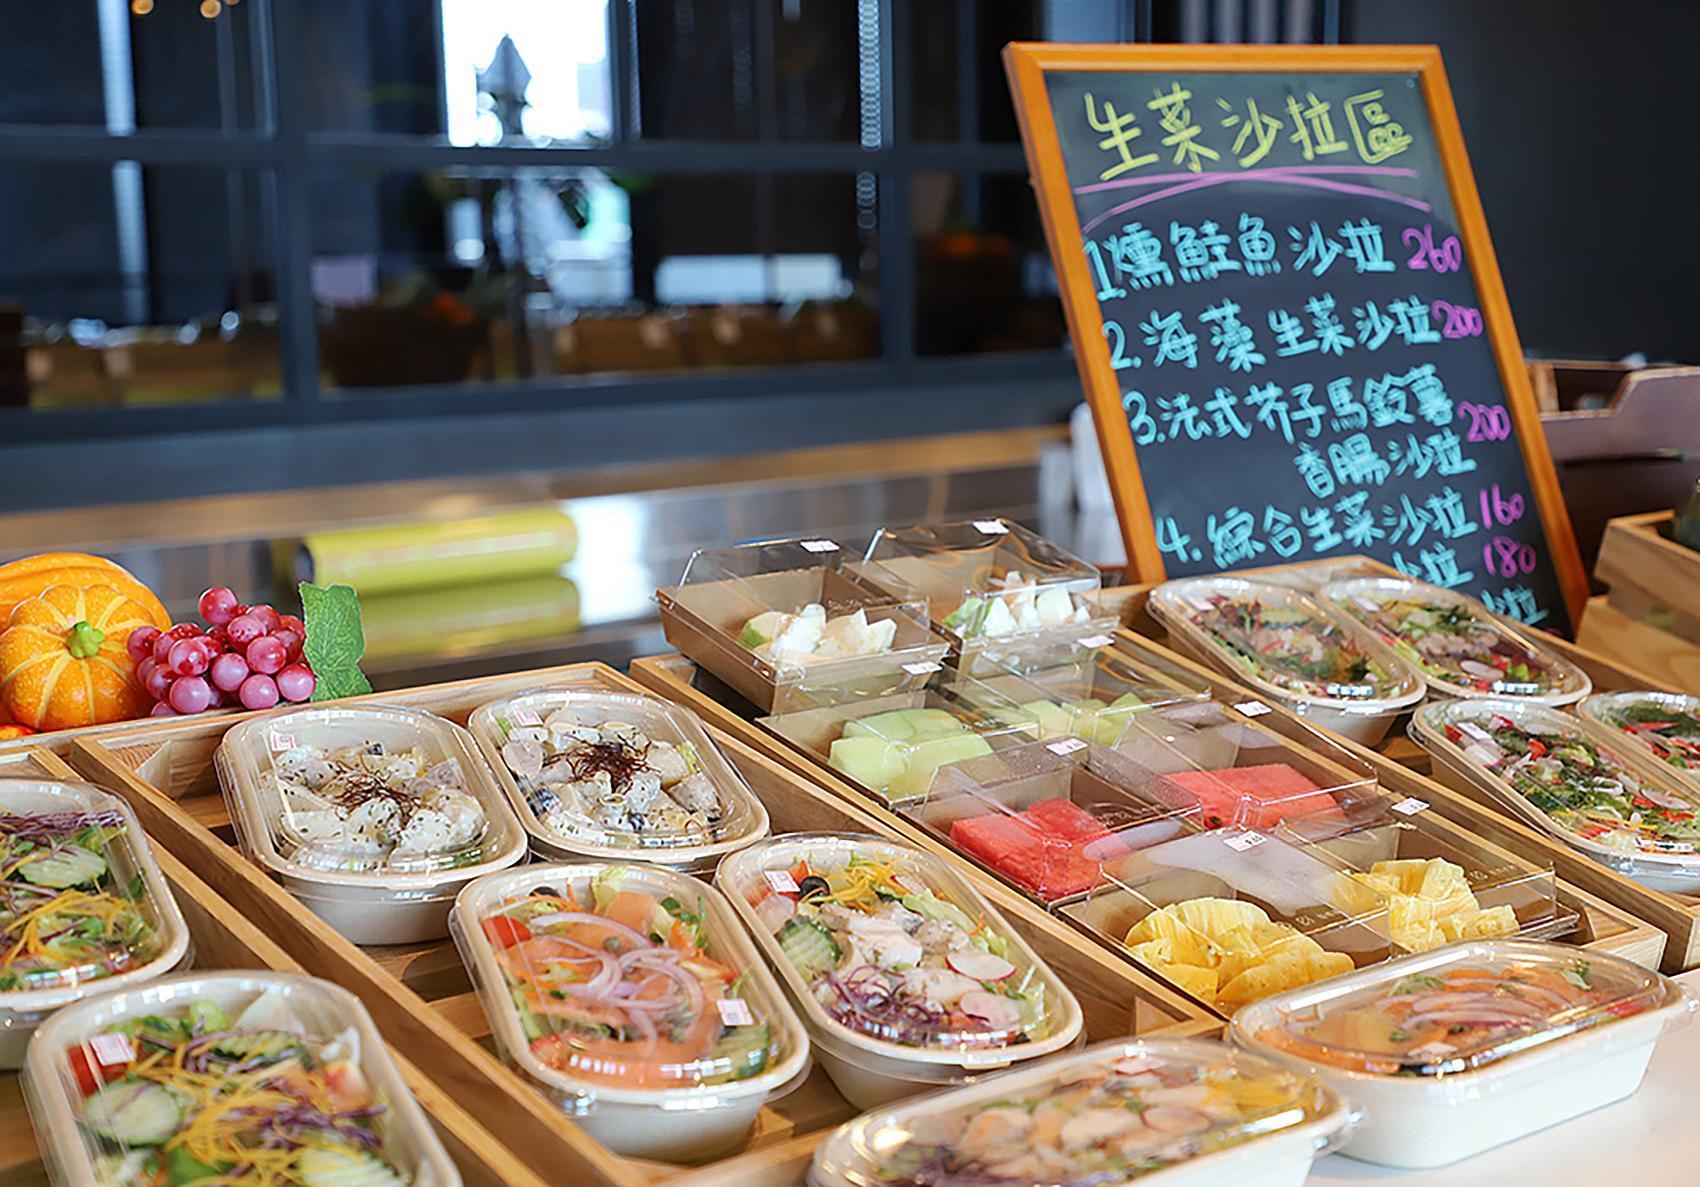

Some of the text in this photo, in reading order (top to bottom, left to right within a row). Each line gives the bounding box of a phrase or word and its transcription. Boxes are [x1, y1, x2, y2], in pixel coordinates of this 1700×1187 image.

[1085, 81, 1413, 181] 生菜沙拉區
[1402, 223, 1462, 273] 260
[1432, 300, 1483, 340] 200
[1457, 401, 1511, 442] 200
[1293, 427, 1477, 499] 香腸沙拉
[1480, 483, 1524, 529] 160
[1483, 535, 1536, 578] 180
